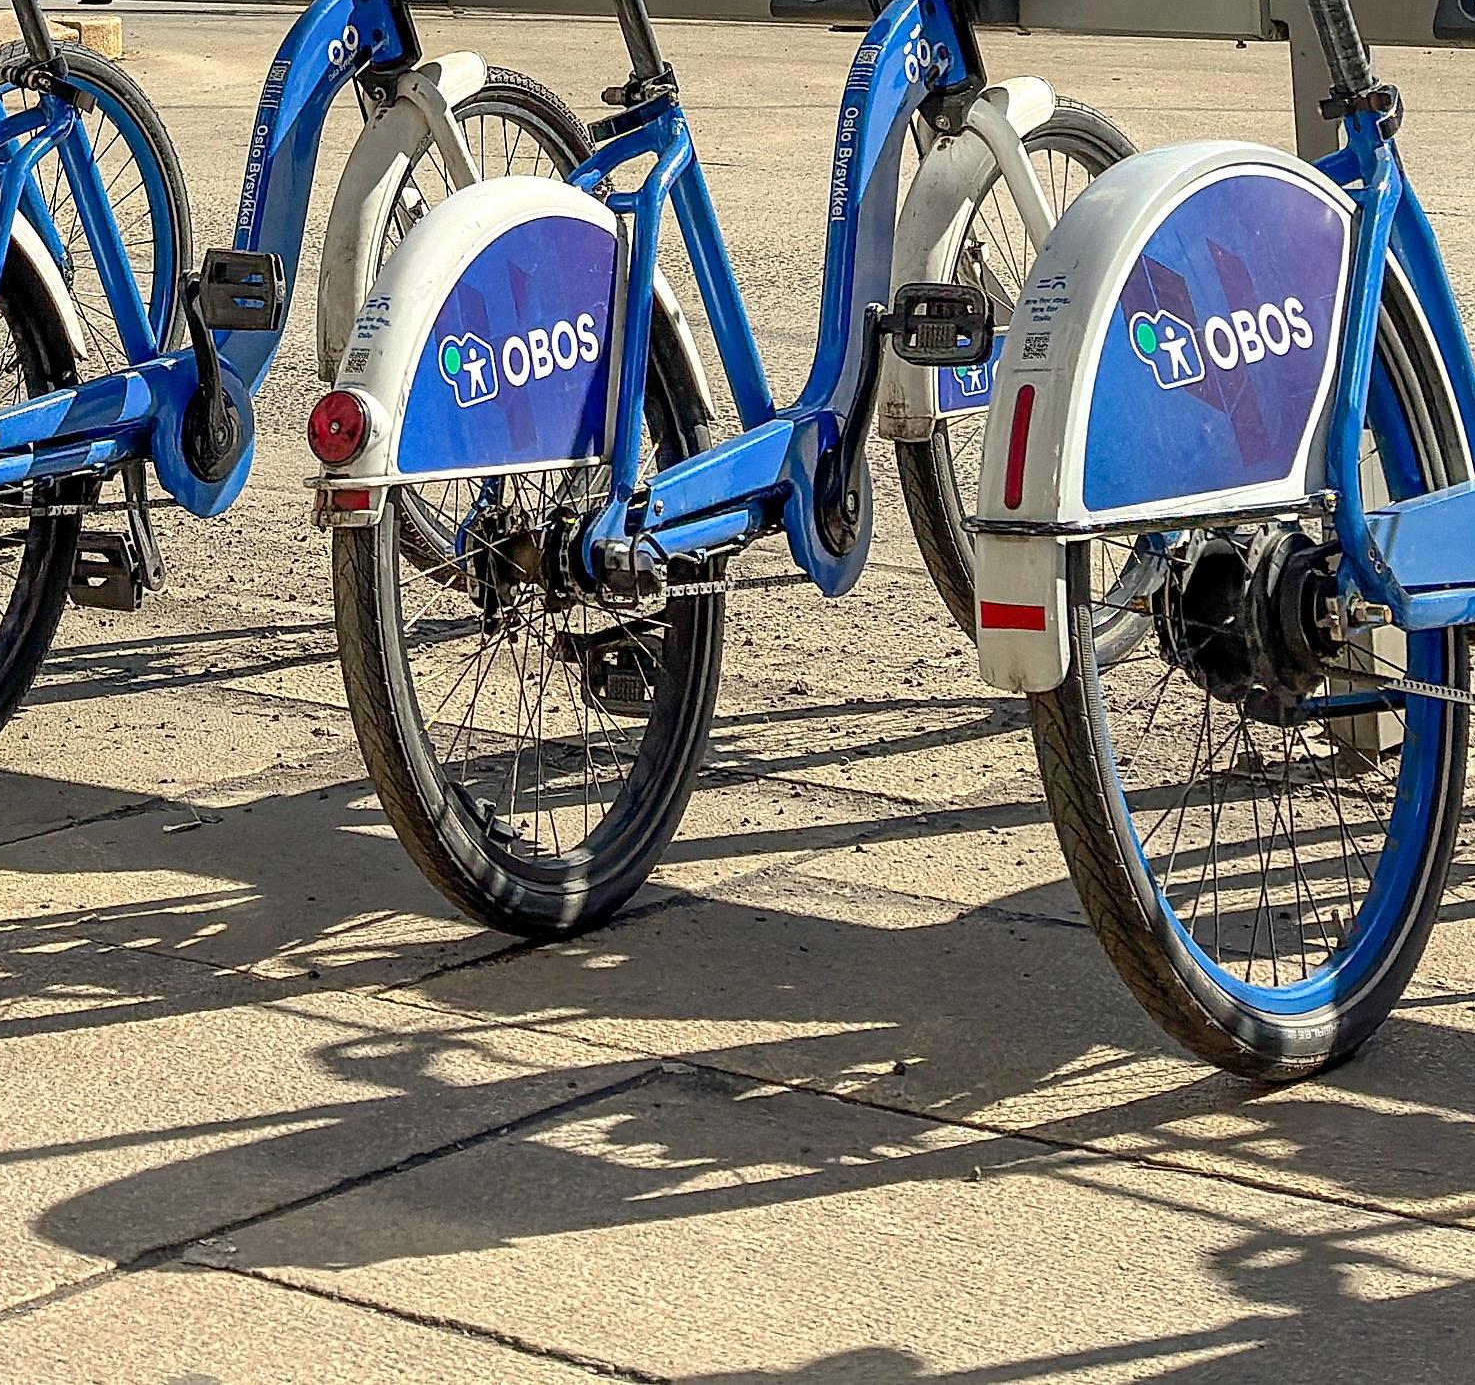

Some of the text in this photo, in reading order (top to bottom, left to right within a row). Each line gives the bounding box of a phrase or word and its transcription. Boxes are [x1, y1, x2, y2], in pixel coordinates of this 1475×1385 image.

[238, 124, 269, 231] Oslo Bysykkel
[831, 107, 859, 222] Oslo Bysykkel
[502, 312, 600, 387] OBOS
[1204, 296, 1314, 370] OBOS
